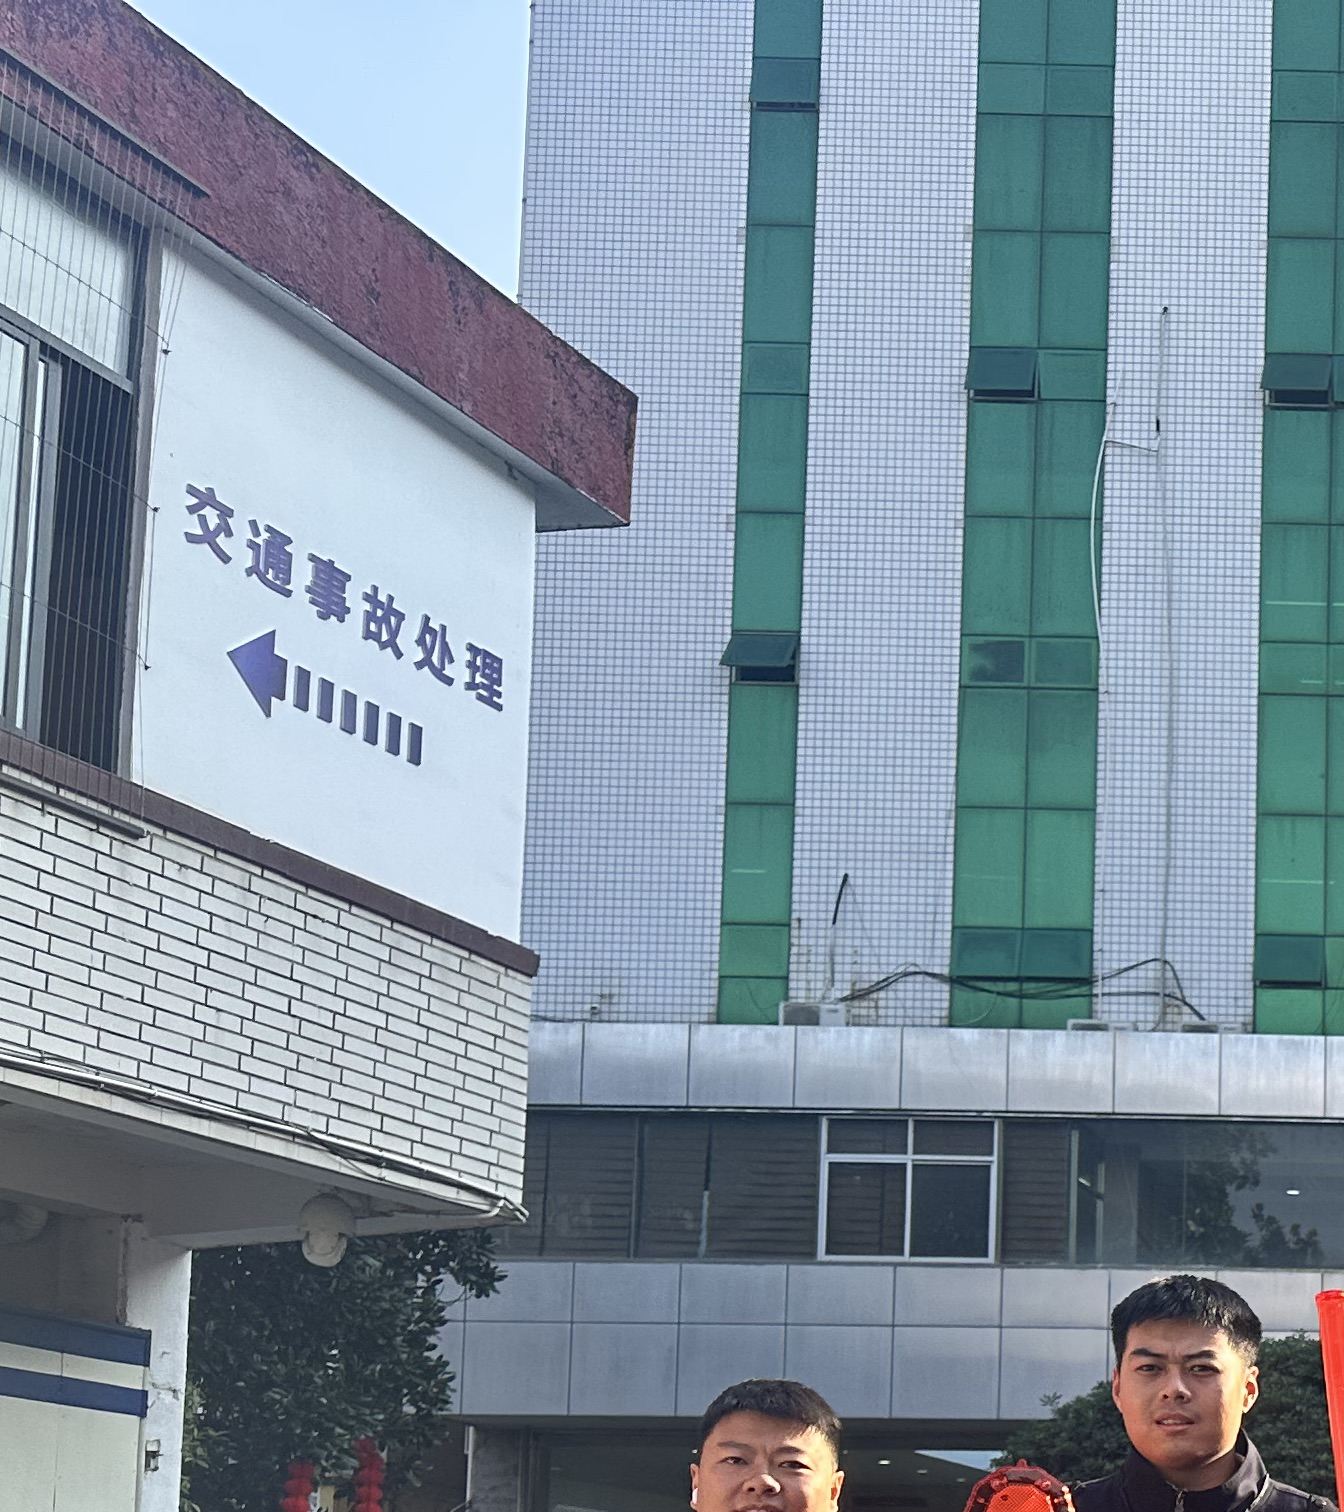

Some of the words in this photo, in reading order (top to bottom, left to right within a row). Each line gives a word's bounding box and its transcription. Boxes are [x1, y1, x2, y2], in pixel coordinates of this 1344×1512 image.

[184, 483, 503, 712] 交通事故处理
